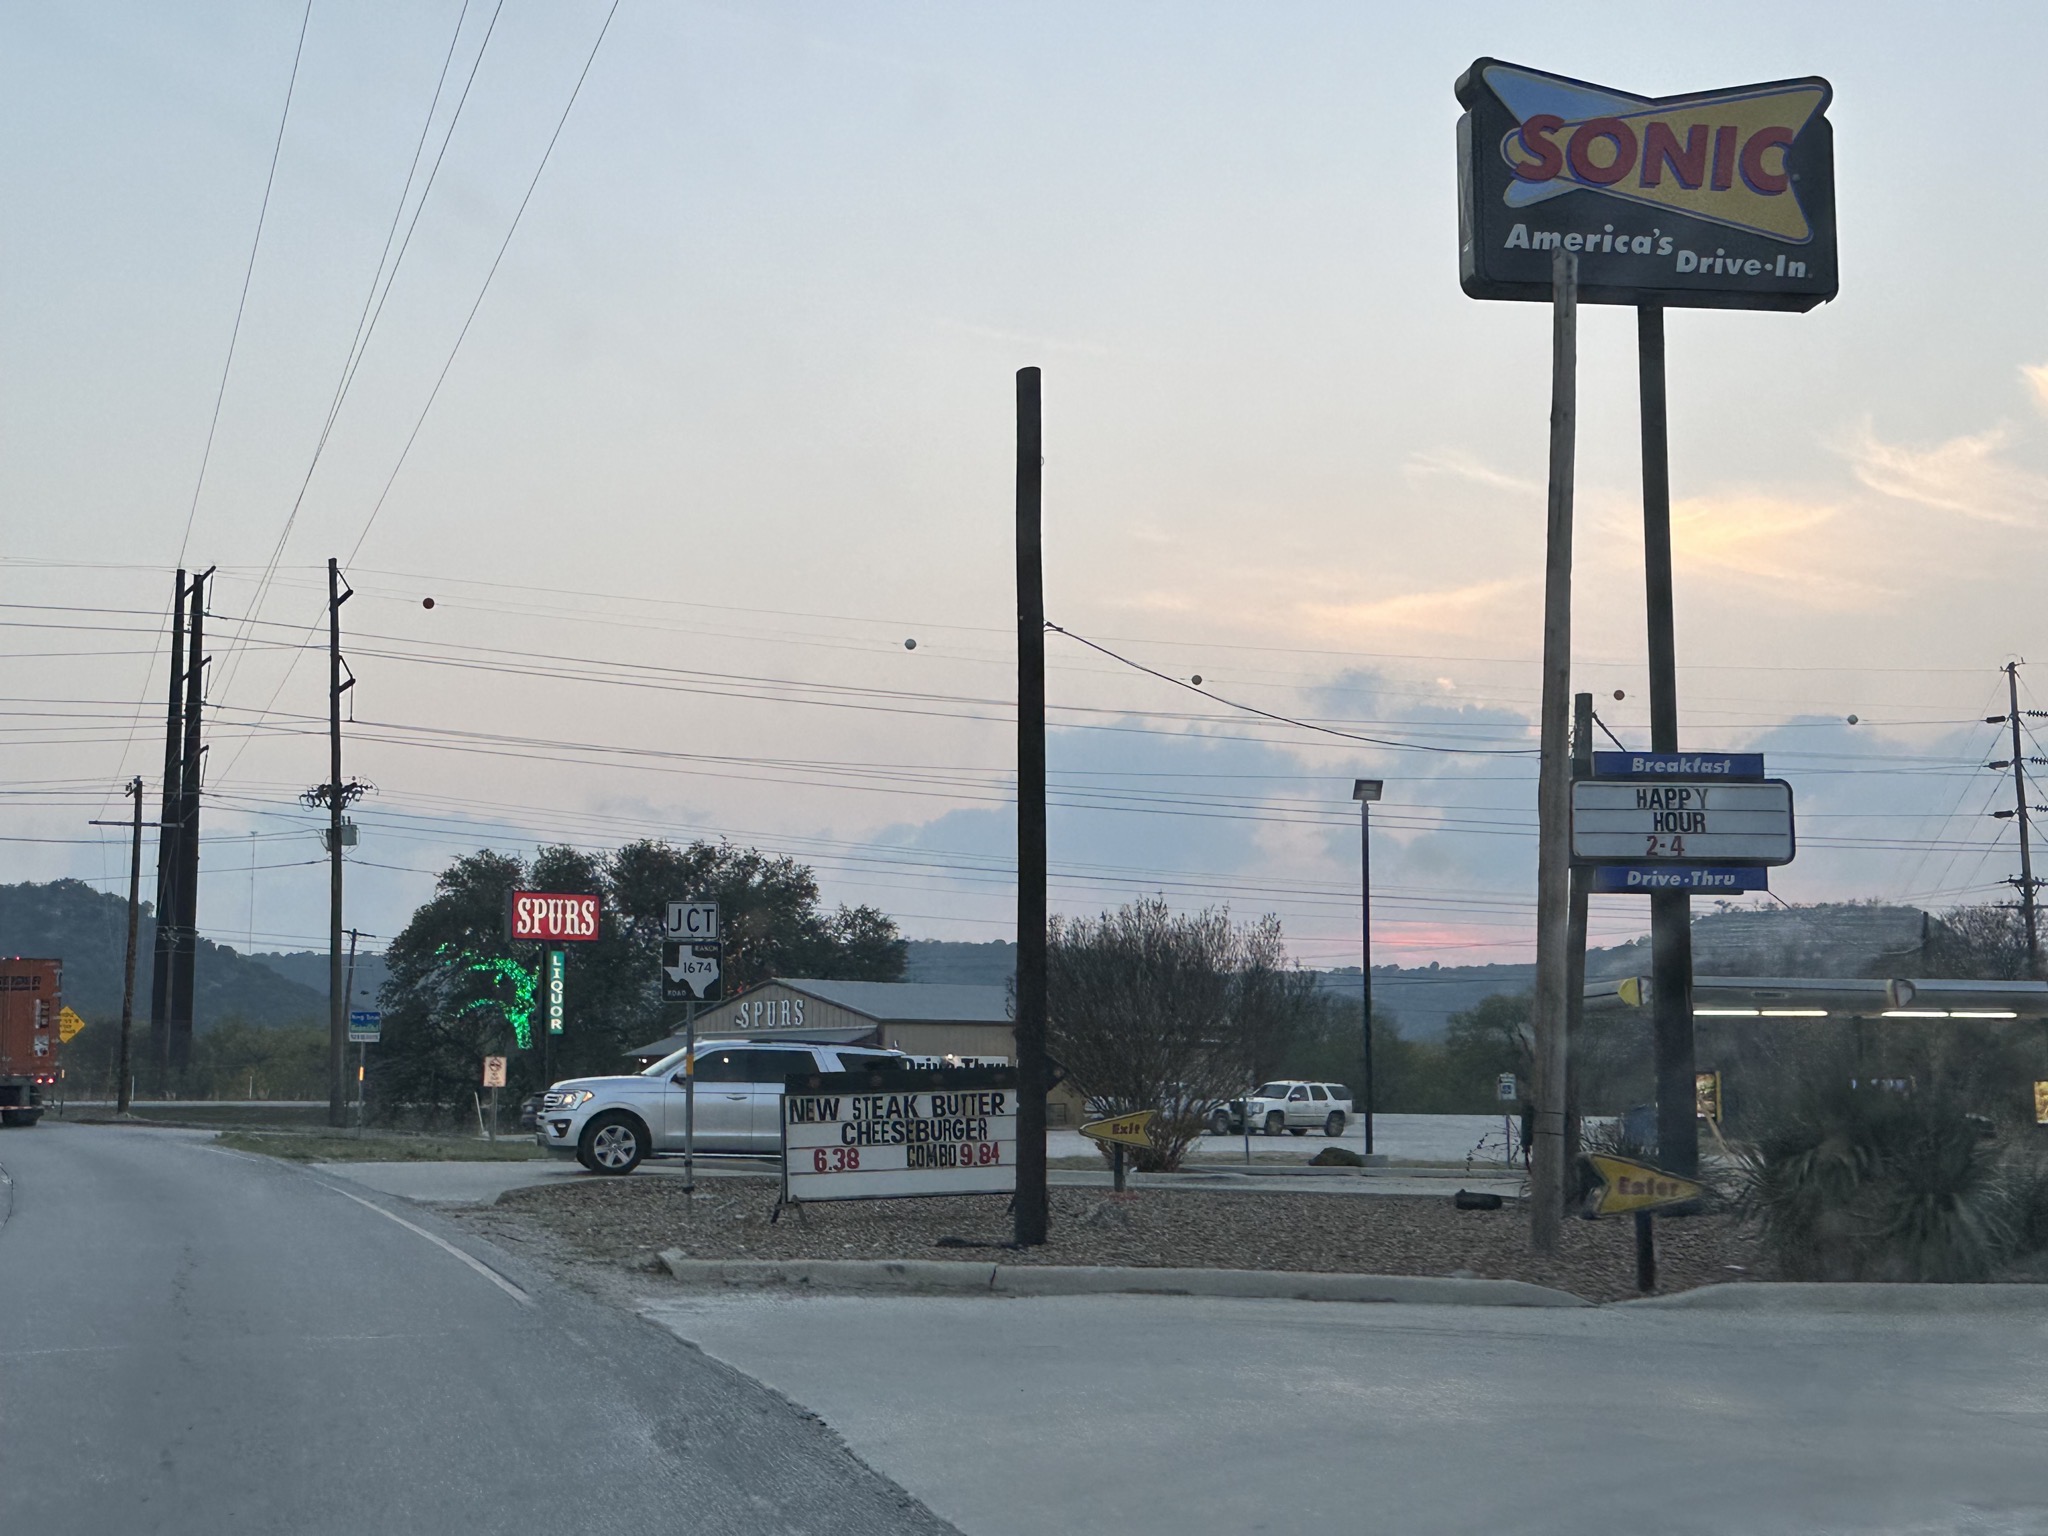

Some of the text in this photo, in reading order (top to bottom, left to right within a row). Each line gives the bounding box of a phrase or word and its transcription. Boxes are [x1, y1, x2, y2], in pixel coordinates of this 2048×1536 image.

[1511, 114, 1794, 196] SONIC
[1504, 223, 1674, 255] America's
[1631, 757, 1731, 773] Breakfast
[1636, 788, 1708, 810] HAPPY
[1653, 812, 1706, 833] HOUR
[517, 897, 595, 935] SPURS
[670, 908, 715, 932] JCT
[684, 962, 712, 974] 1674
[550, 955, 563, 1030] LIQUOR
[735, 999, 804, 1028] SPURS
[789, 1093, 1005, 1122] NEW STEAK BUTTER
[841, 1118, 988, 1145] CHEESEBURGER
[1112, 1122, 1140, 1135] Exit
[813, 1142, 1000, 1173] 6.38 COMBO 9.84
